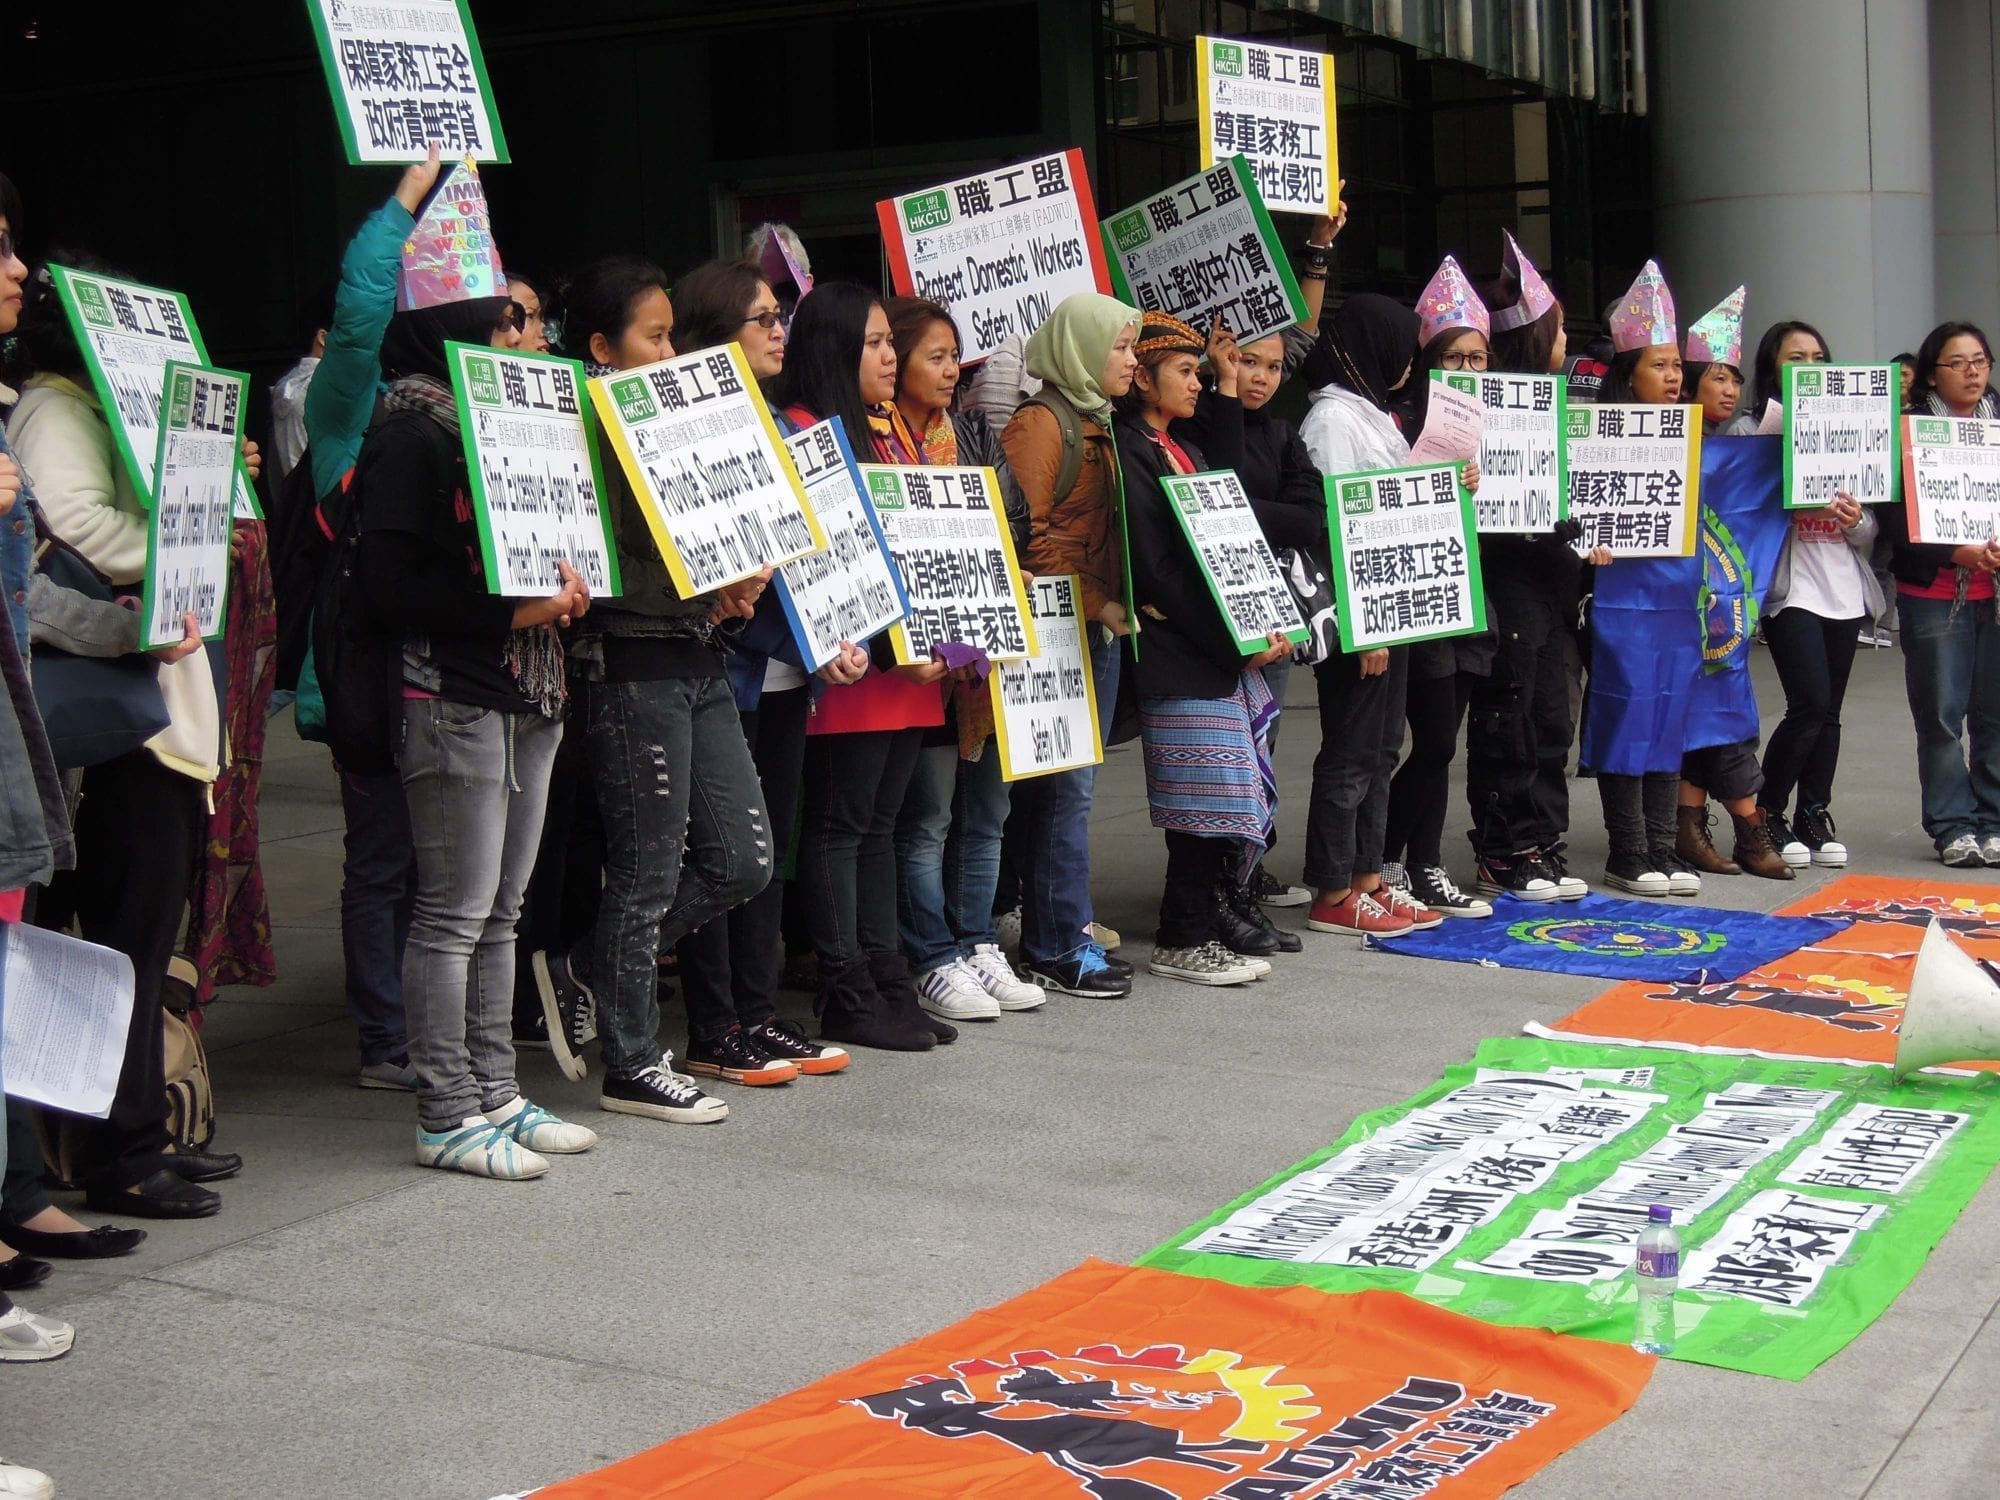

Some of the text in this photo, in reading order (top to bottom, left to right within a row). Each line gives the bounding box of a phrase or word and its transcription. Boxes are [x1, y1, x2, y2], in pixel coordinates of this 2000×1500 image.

[340, 39, 476, 94] 保障家務工安全
[1215, 59, 1241, 73] HKCTU
[1219, 48, 1237, 59] 工盟
[1247, 48, 1321, 89] 職工盟
[361, 97, 482, 151] 政府責無旁貸
[1213, 110, 1322, 161] 尊重家務工
[953, 157, 1070, 219] 職工盟
[1216, 156, 1324, 204] 性侵犯
[912, 195, 940, 214] 工盟
[1032, 201, 1073, 231] (FADWU)
[1147, 166, 1241, 234] 職工盟
[909, 208, 950, 230] HKCTU
[1118, 227, 1149, 247] HKCTU
[1119, 215, 1139, 232] 工盟
[434, 232, 491, 253] WAGE
[449, 252, 489, 269] FOR
[915, 265, 968, 304] Protect
[966, 243, 1029, 296] Domestic
[106, 286, 190, 344] 職工盟
[972, 290, 1051, 351] Safety NOW
[471, 381, 499, 401] HKCTU
[473, 363, 492, 382] 工盟
[500, 361, 579, 415] 職工盟
[648, 353, 743, 413] 職工盟
[1798, 385, 1821, 395] HKCTU
[1801, 372, 1817, 384] 工盟
[1826, 370, 1889, 397] 職工盟
[192, 376, 238, 435] 職工盟
[619, 382, 644, 402] 工盟
[621, 397, 655, 422] HKCTU
[1482, 377, 1553, 411] 職工盟
[1597, 408, 1685, 439] 職工盟
[1794, 419, 1889, 458] Abolish Mandatory Live-in
[1919, 432, 1949, 442] HKCTU
[785, 425, 842, 482] 工盟
[1480, 440, 1524, 482] Mandatory
[1528, 438, 1555, 477] Live-in
[483, 454, 508, 521] Stop
[573, 463, 598, 517] Fees
[648, 456, 706, 517] Provide
[692, 448, 754, 509] Supports
[748, 434, 775, 489] and
[875, 476, 897, 492] 工盟
[903, 472, 990, 511] 職工盟
[1347, 487, 1367, 500] 工盟
[1377, 471, 1456, 512] 職工盟
[1567, 469, 1683, 507] 障家務工安全
[1802, 463, 1885, 501] requirement on MDWs
[1919, 470, 1960, 504] Respect
[874, 491, 903, 507] HKCTU
[1192, 476, 1248, 513] 職工盟
[1345, 498, 1372, 512] HKCTU
[1509, 503, 1520, 527] on
[1524, 489, 1551, 527] MDWs
[1934, 508, 1995, 541] Stop Sexual
[674, 530, 728, 589] Shelter
[715, 523, 740, 574] for
[1350, 537, 1465, 592] 保障家務工安全
[1361, 582, 1462, 635] 政府責無旁貸
